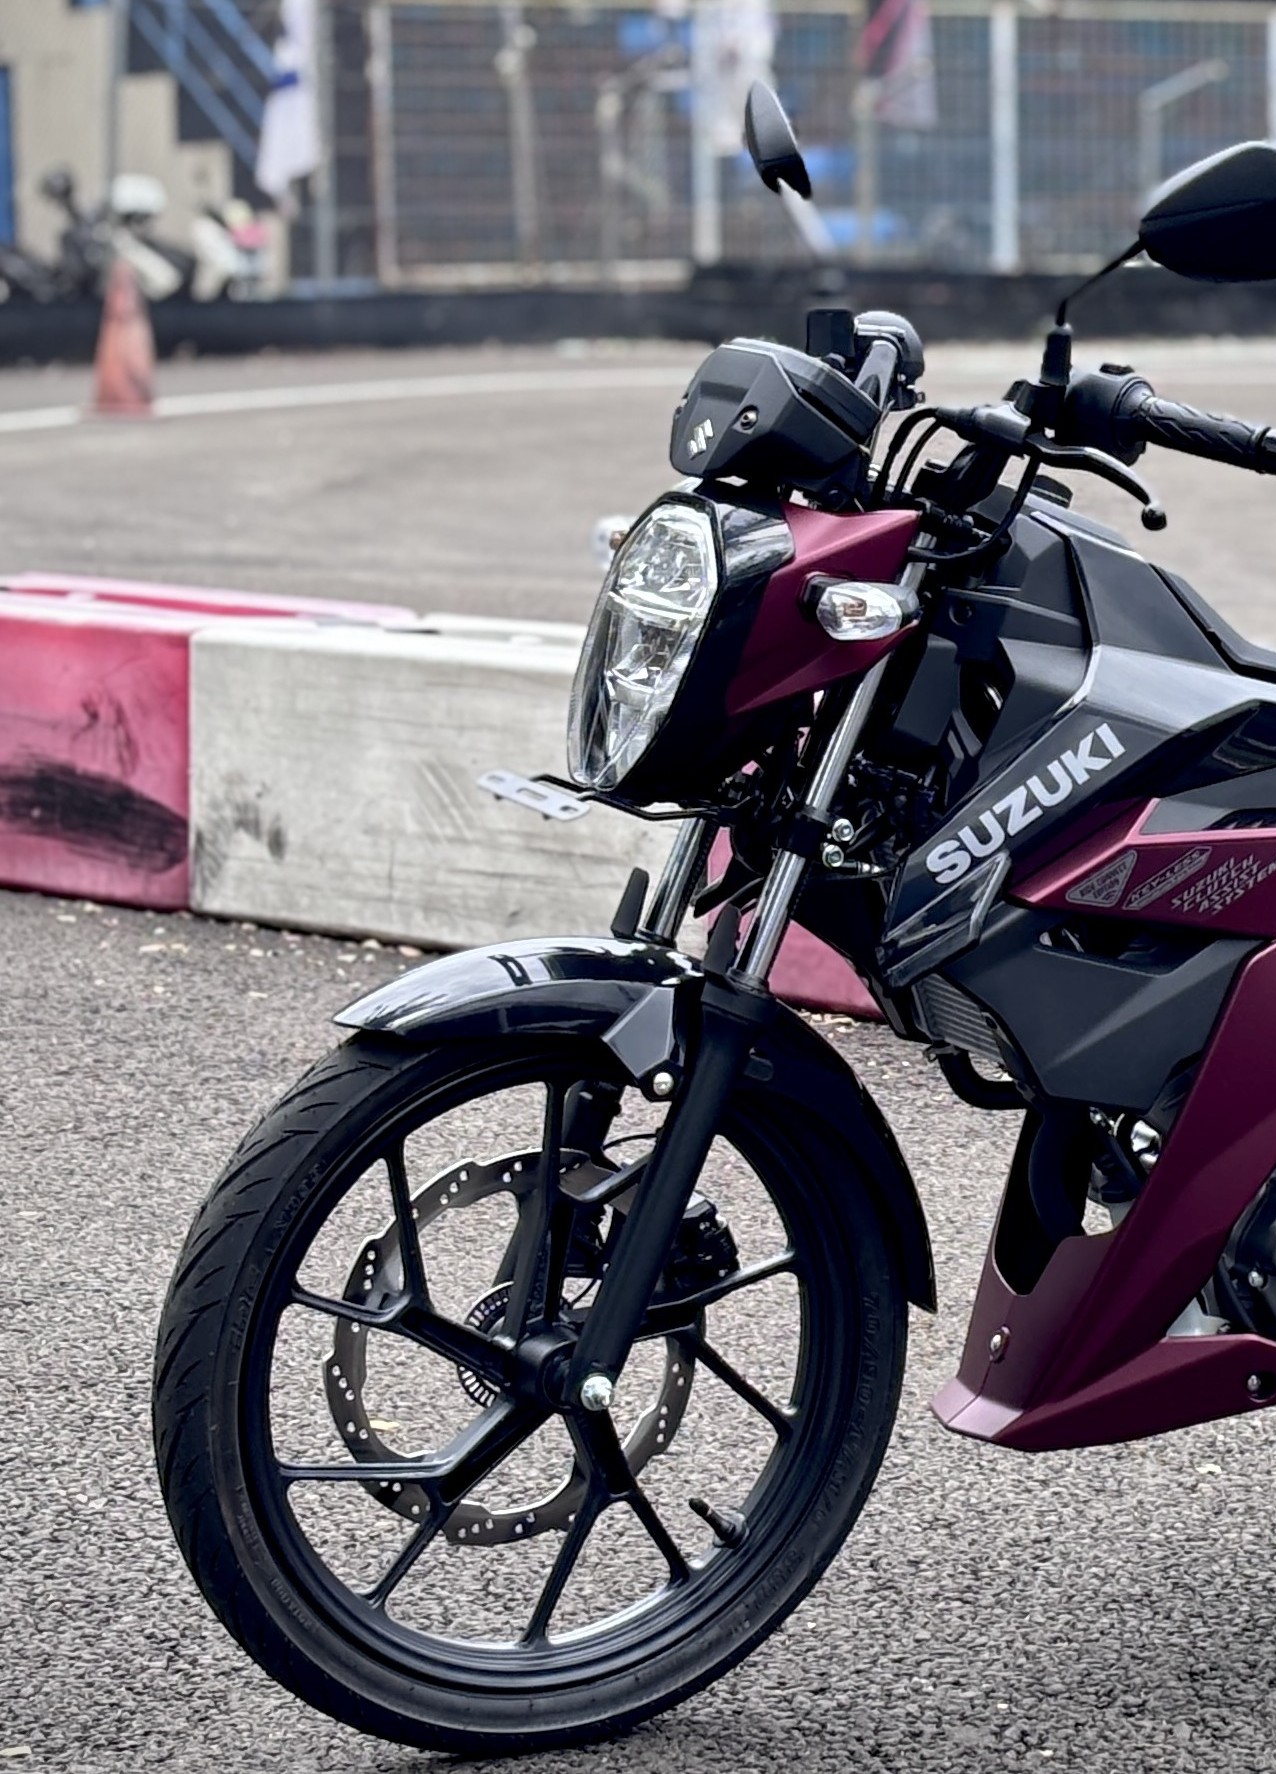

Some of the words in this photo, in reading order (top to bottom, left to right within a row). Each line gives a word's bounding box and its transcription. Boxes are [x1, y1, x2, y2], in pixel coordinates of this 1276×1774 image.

[926, 723, 1126, 884] SUZUKI
[1170, 857, 1235, 910] SUZUKI
[1183, 853, 1254, 913] CLUTCH
[1199, 860, 1261, 913] ASSIST
